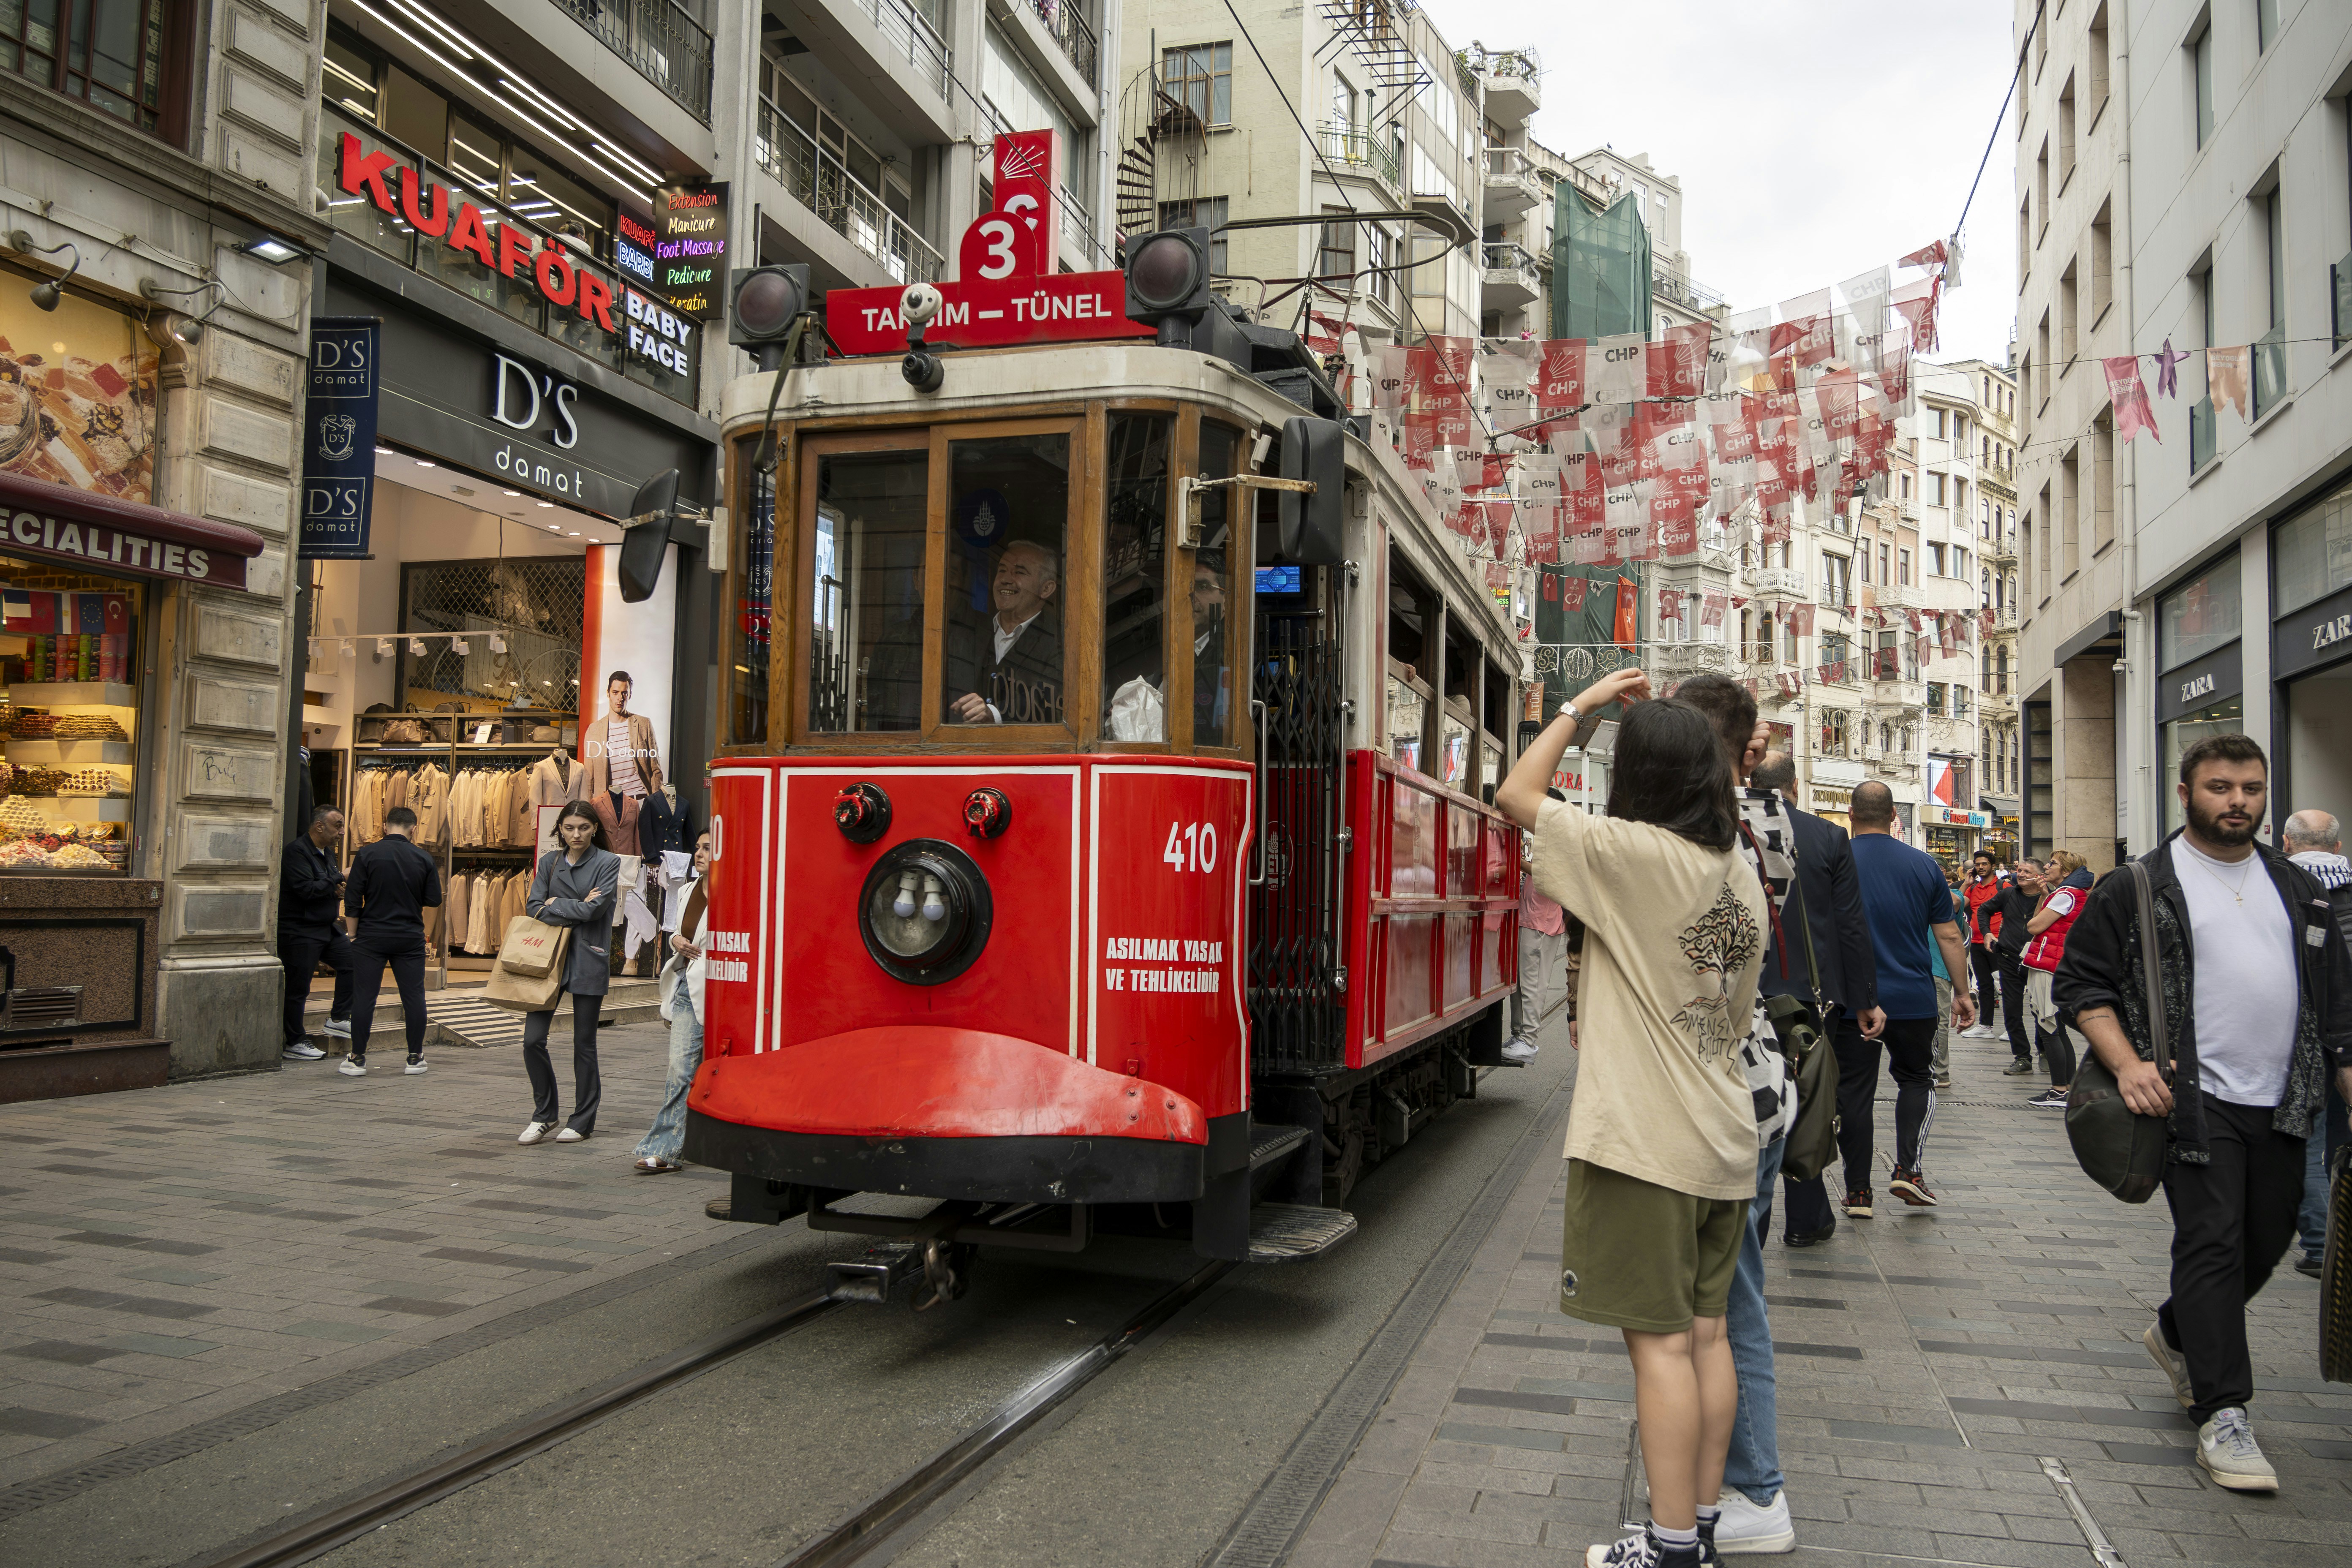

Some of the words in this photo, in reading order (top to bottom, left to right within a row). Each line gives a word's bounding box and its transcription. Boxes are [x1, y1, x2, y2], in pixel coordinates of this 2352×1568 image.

[668, 189, 718, 210] Extension
[668, 214, 716, 234] Manicure
[338, 131, 615, 334] KUAFÖR
[657, 240, 681, 259] Foot
[683, 239, 724, 259] Massage
[978, 220, 1016, 280] 3
[620, 242, 654, 281] BARB
[667, 266, 711, 286] Pedicure
[1850, 277, 1886, 299] CHP
[628, 291, 691, 346] BABY
[862, 302, 969, 332] TAIM
[1011, 291, 1112, 322] TÜNEL
[1799, 329, 1833, 351] CHP
[316, 340, 365, 368] D'S
[629, 325, 688, 377] FACE
[1605, 346, 1639, 362] CHP
[1708, 348, 1729, 363] HP
[315, 372, 365, 385] damat
[1434, 373, 1465, 384] CHP
[1675, 369, 1705, 384] CHP
[1496, 389, 1524, 400] CHP
[1547, 381, 1578, 396] CHP
[1708, 390, 1738, 401] CHP
[493, 353, 578, 449] D'S
[1422, 397, 1452, 409] CHP
[1767, 393, 1796, 410] CHP
[1831, 412, 1859, 428] CHP
[1437, 423, 1465, 434] CHP
[1668, 432, 1695, 446] CHP
[1725, 433, 1754, 451] CHP
[1760, 435, 1786, 450] CHP
[1456, 451, 1482, 462] CHP
[1565, 453, 1585, 465] HP
[1725, 454, 1753, 465] CHP
[496, 445, 583, 498] damat
[1614, 459, 1637, 475] CHP
[1786, 458, 1811, 473] CHP
[1531, 479, 1555, 489] CHP
[1679, 475, 1705, 485] CHP
[308, 487, 357, 516] D'S
[1578, 496, 1600, 508] CHP
[1608, 493, 1632, 504] CHP
[1654, 499, 1680, 510] CHP
[306, 520, 355, 532] damat
[1580, 527, 1603, 539] CHP
[1618, 527, 1641, 538] CHP
[1668, 532, 1690, 544] CHP
[1533, 542, 1552, 552] CHP
[1703, 588, 1721, 597] KANADA
[2313, 615, 2352, 649] ZAR
[2181, 674, 2216, 702] ZARA
[1529, 691, 1541, 722] ÜLTÜR
[585, 740, 614, 758] D'S
[619, 746, 662, 758] damat
[1550, 770, 1593, 792] ORA
[1164, 822, 1217, 874] 410
[520, 936, 544, 948] H&M
[716, 931, 750, 953] YASAK
[1106, 937, 1179, 961] ASILMAK
[1184, 940, 1222, 964] YASAK
[1105, 968, 1124, 991] VE
[1130, 966, 1220, 993] TEHLİKELİDİR
